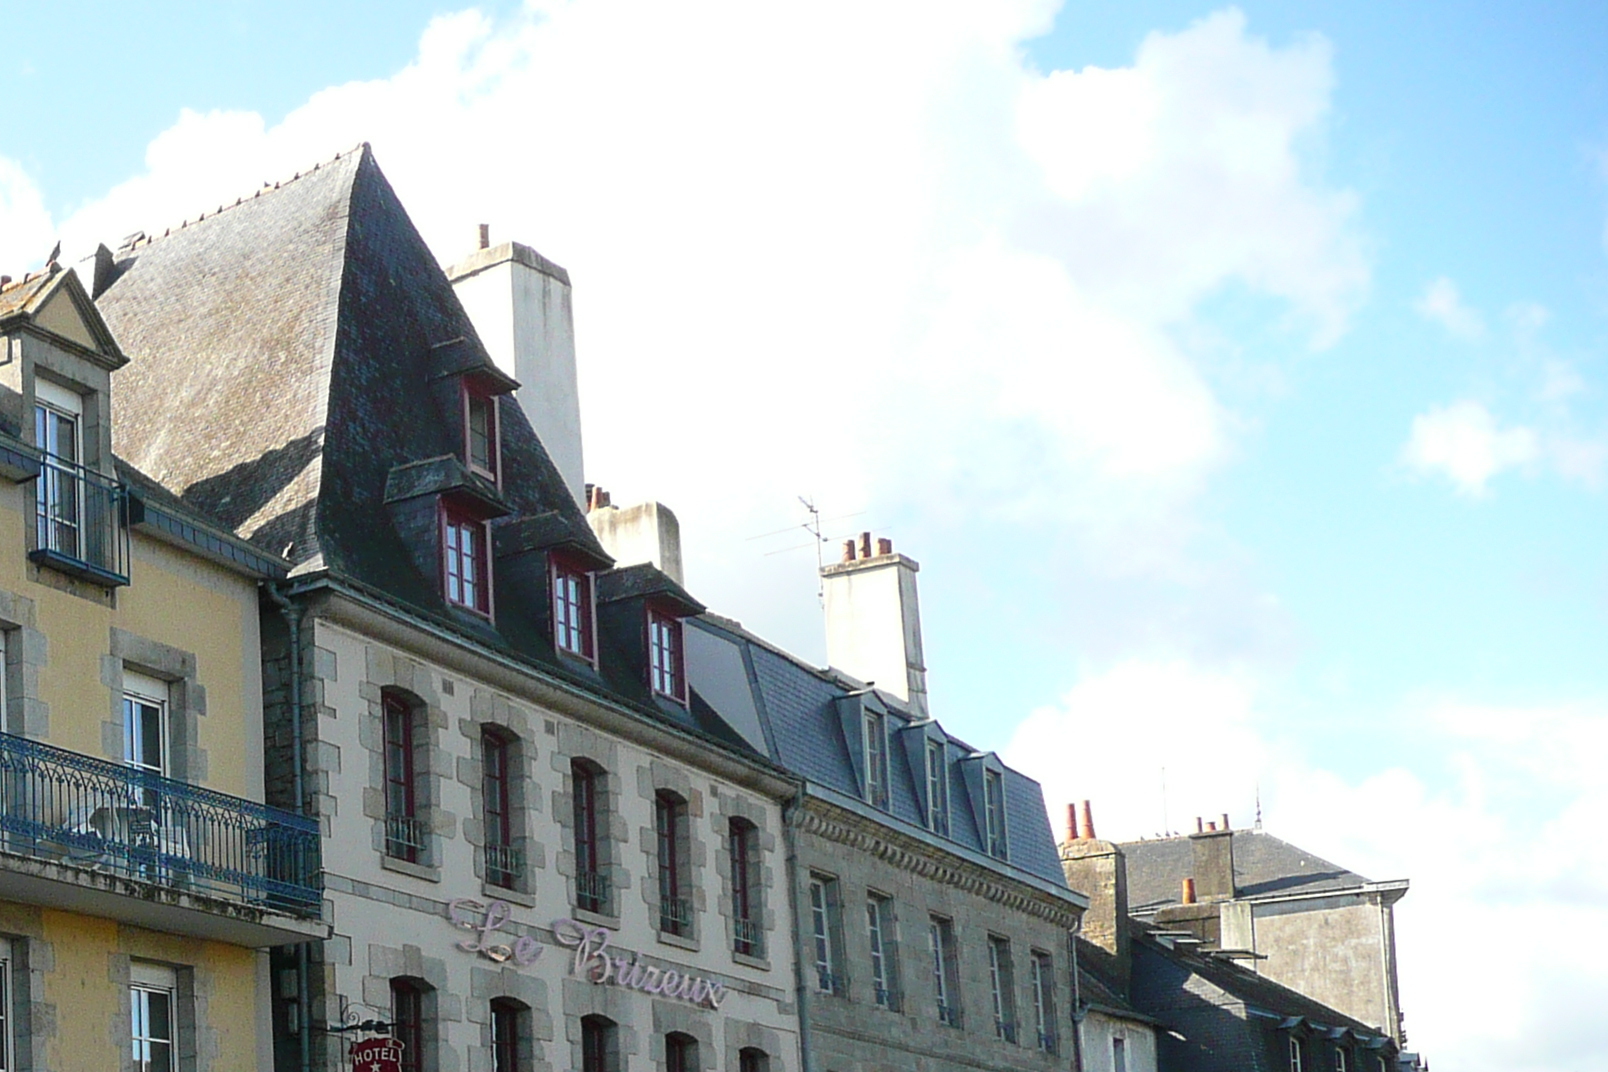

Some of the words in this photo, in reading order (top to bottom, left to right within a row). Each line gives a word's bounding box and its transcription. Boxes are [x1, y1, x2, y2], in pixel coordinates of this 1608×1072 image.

[448, 898, 544, 966] Le
[550, 917, 726, 1009] Brizeux
[354, 1047, 397, 1066] HOTEL
